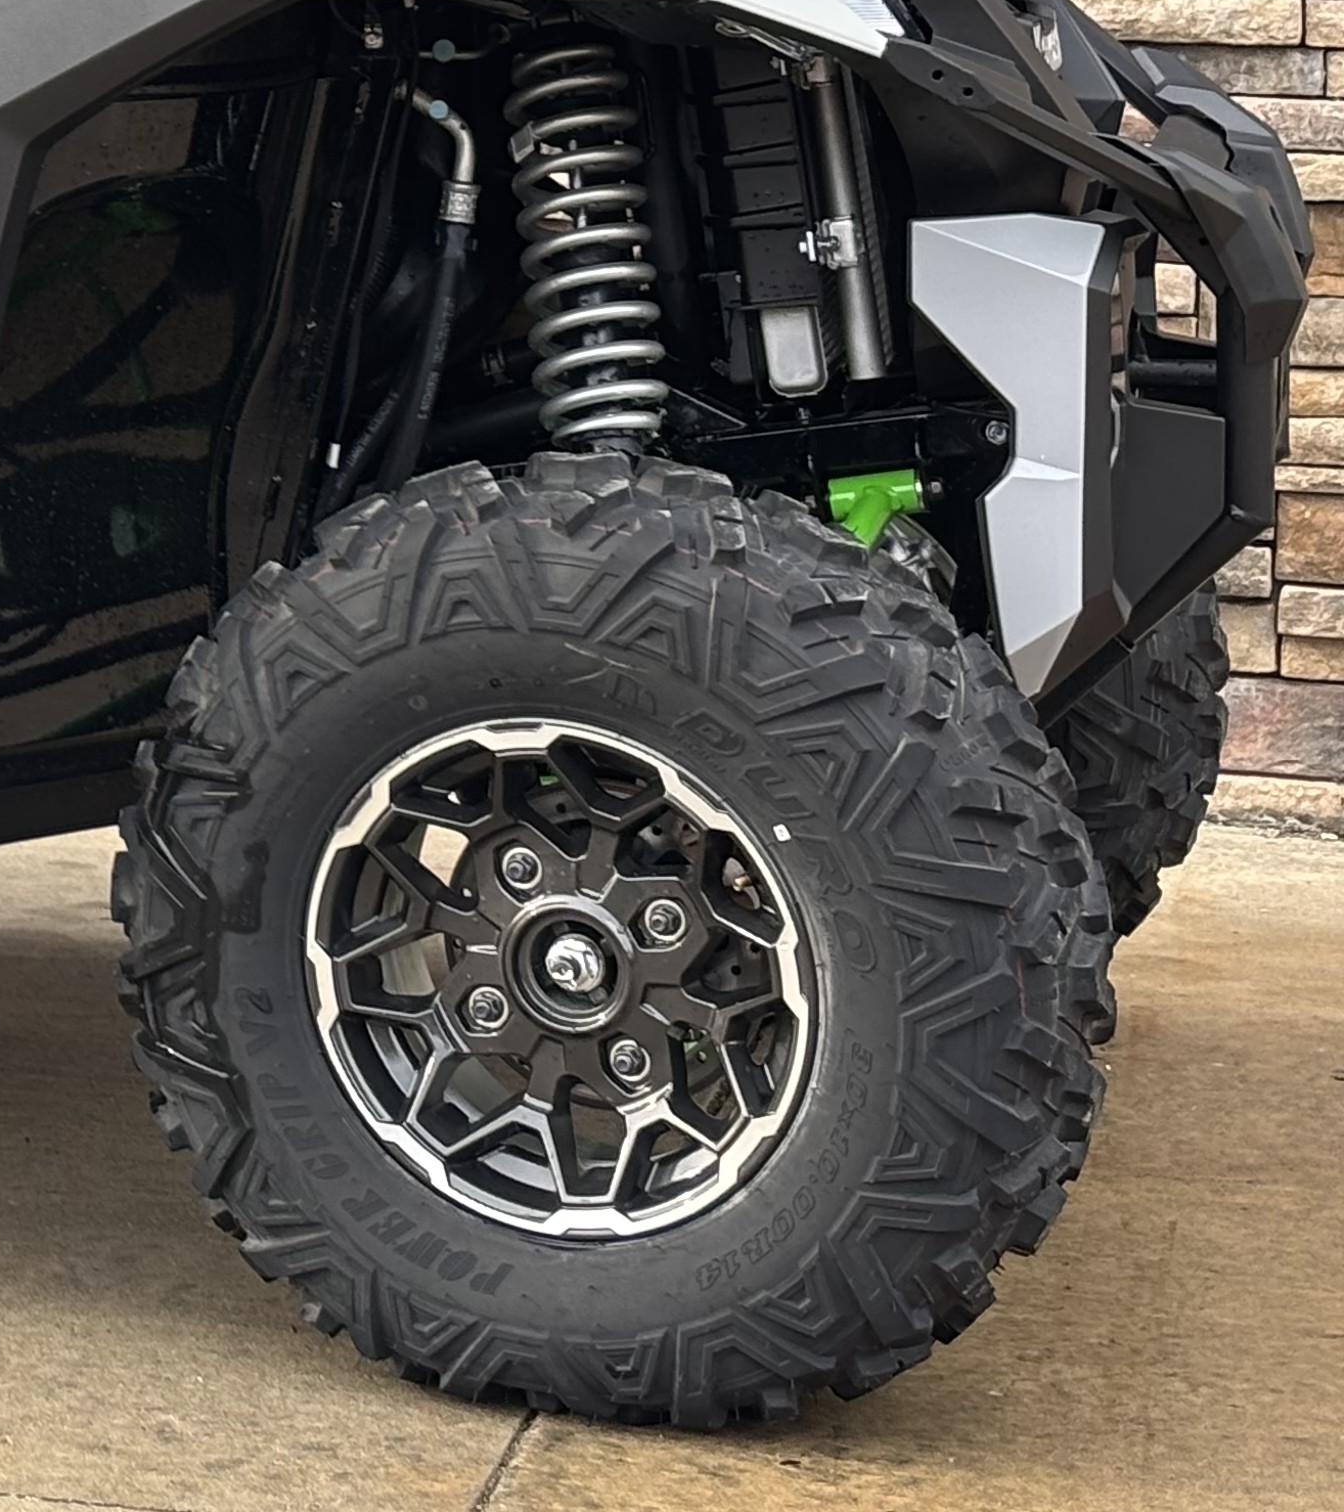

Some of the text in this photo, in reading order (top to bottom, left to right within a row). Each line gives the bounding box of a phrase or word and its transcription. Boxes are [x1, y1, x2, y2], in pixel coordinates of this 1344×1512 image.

[671, 706, 877, 974] DURO
[234, 985, 514, 1297] POWER GRIP V2
[694, 1040, 874, 1290] 30x10.00R14
